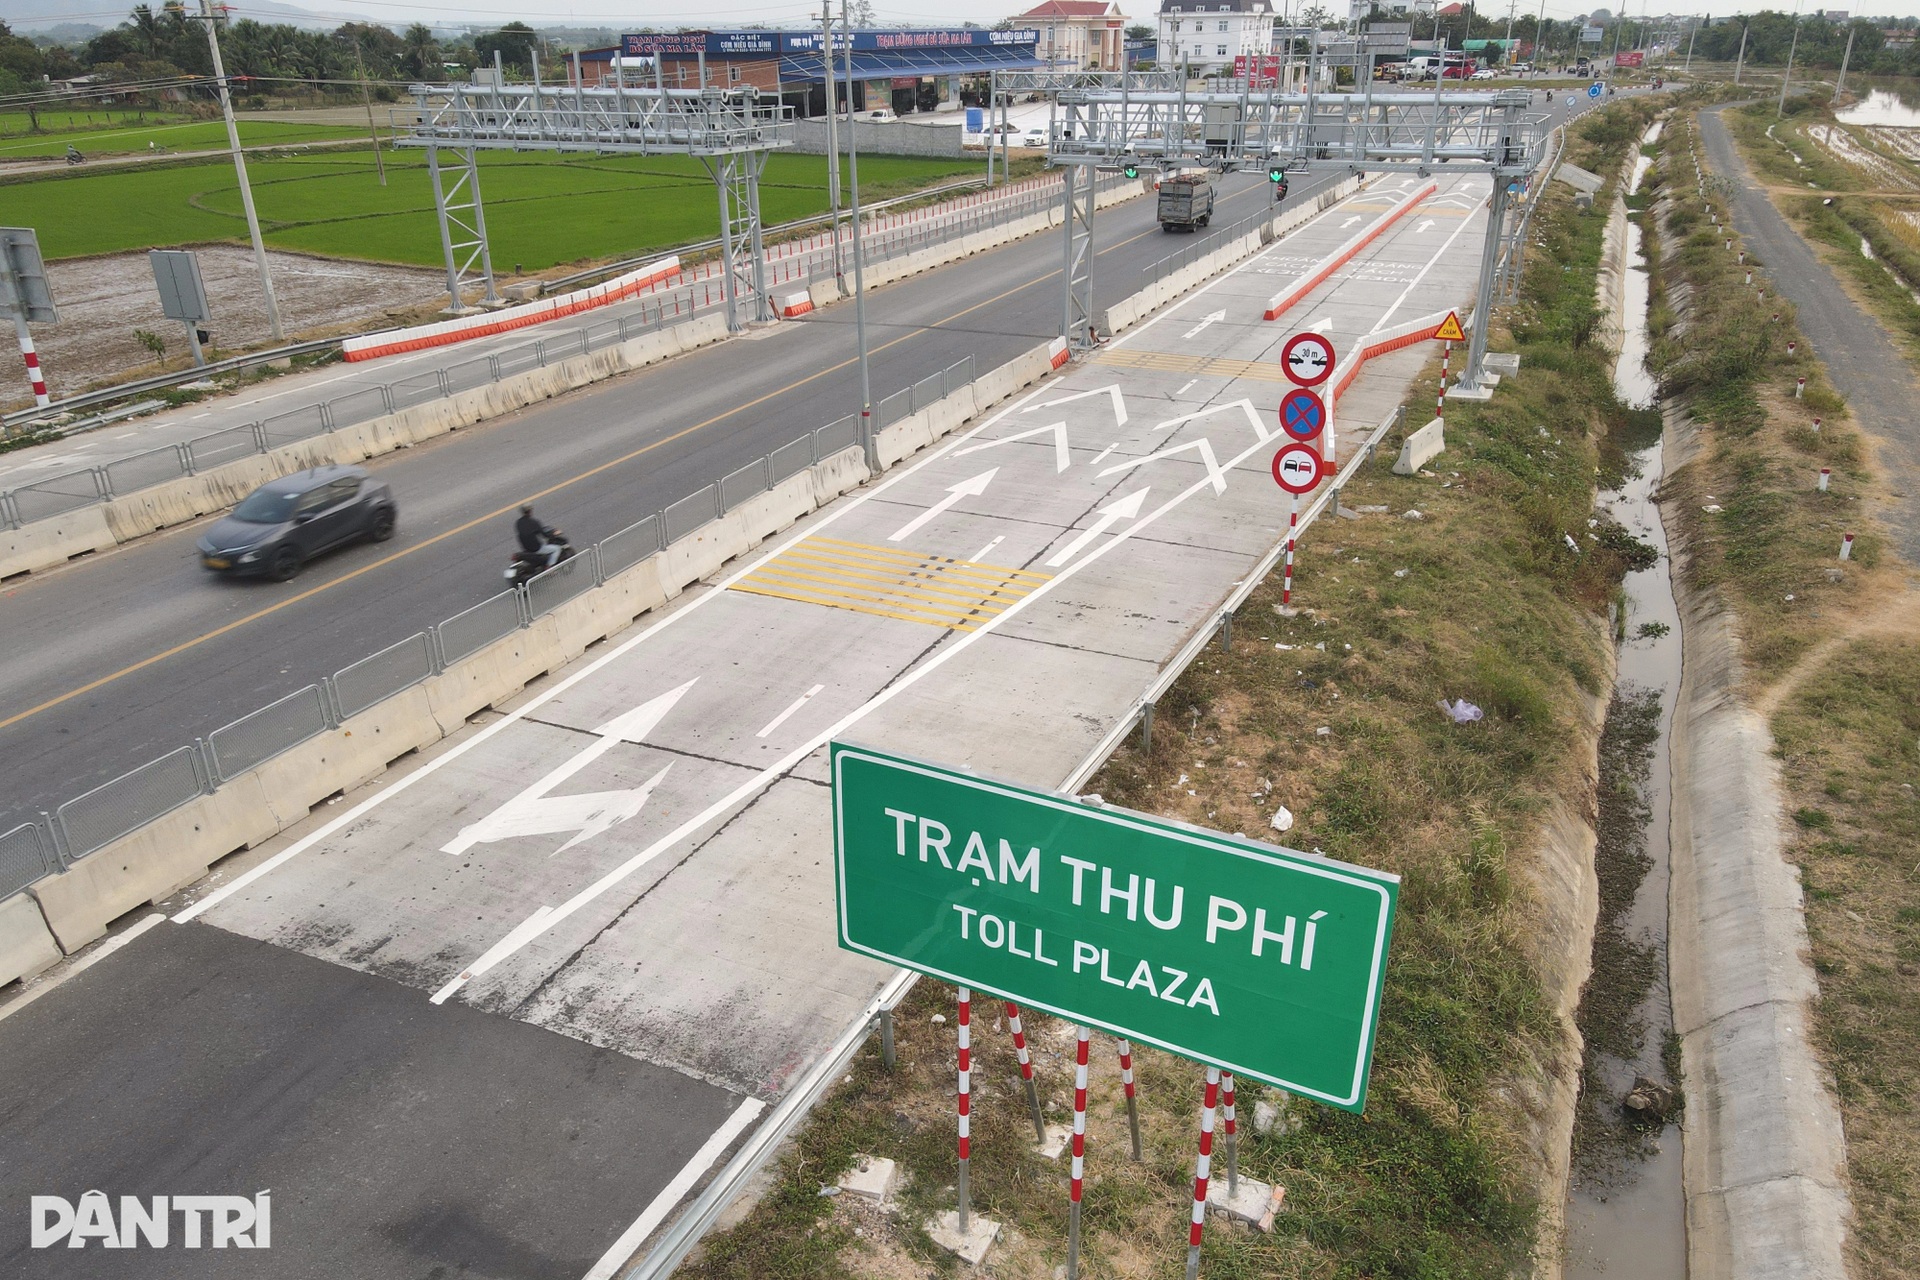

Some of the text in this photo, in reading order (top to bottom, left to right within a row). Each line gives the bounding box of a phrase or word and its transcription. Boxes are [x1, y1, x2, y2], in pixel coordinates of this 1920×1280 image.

[1302, 348, 1310, 358] 30
[884, 807, 1329, 971] TRẠM THU PHÍ
[953, 904, 1221, 1016] TOLL PLAZA
